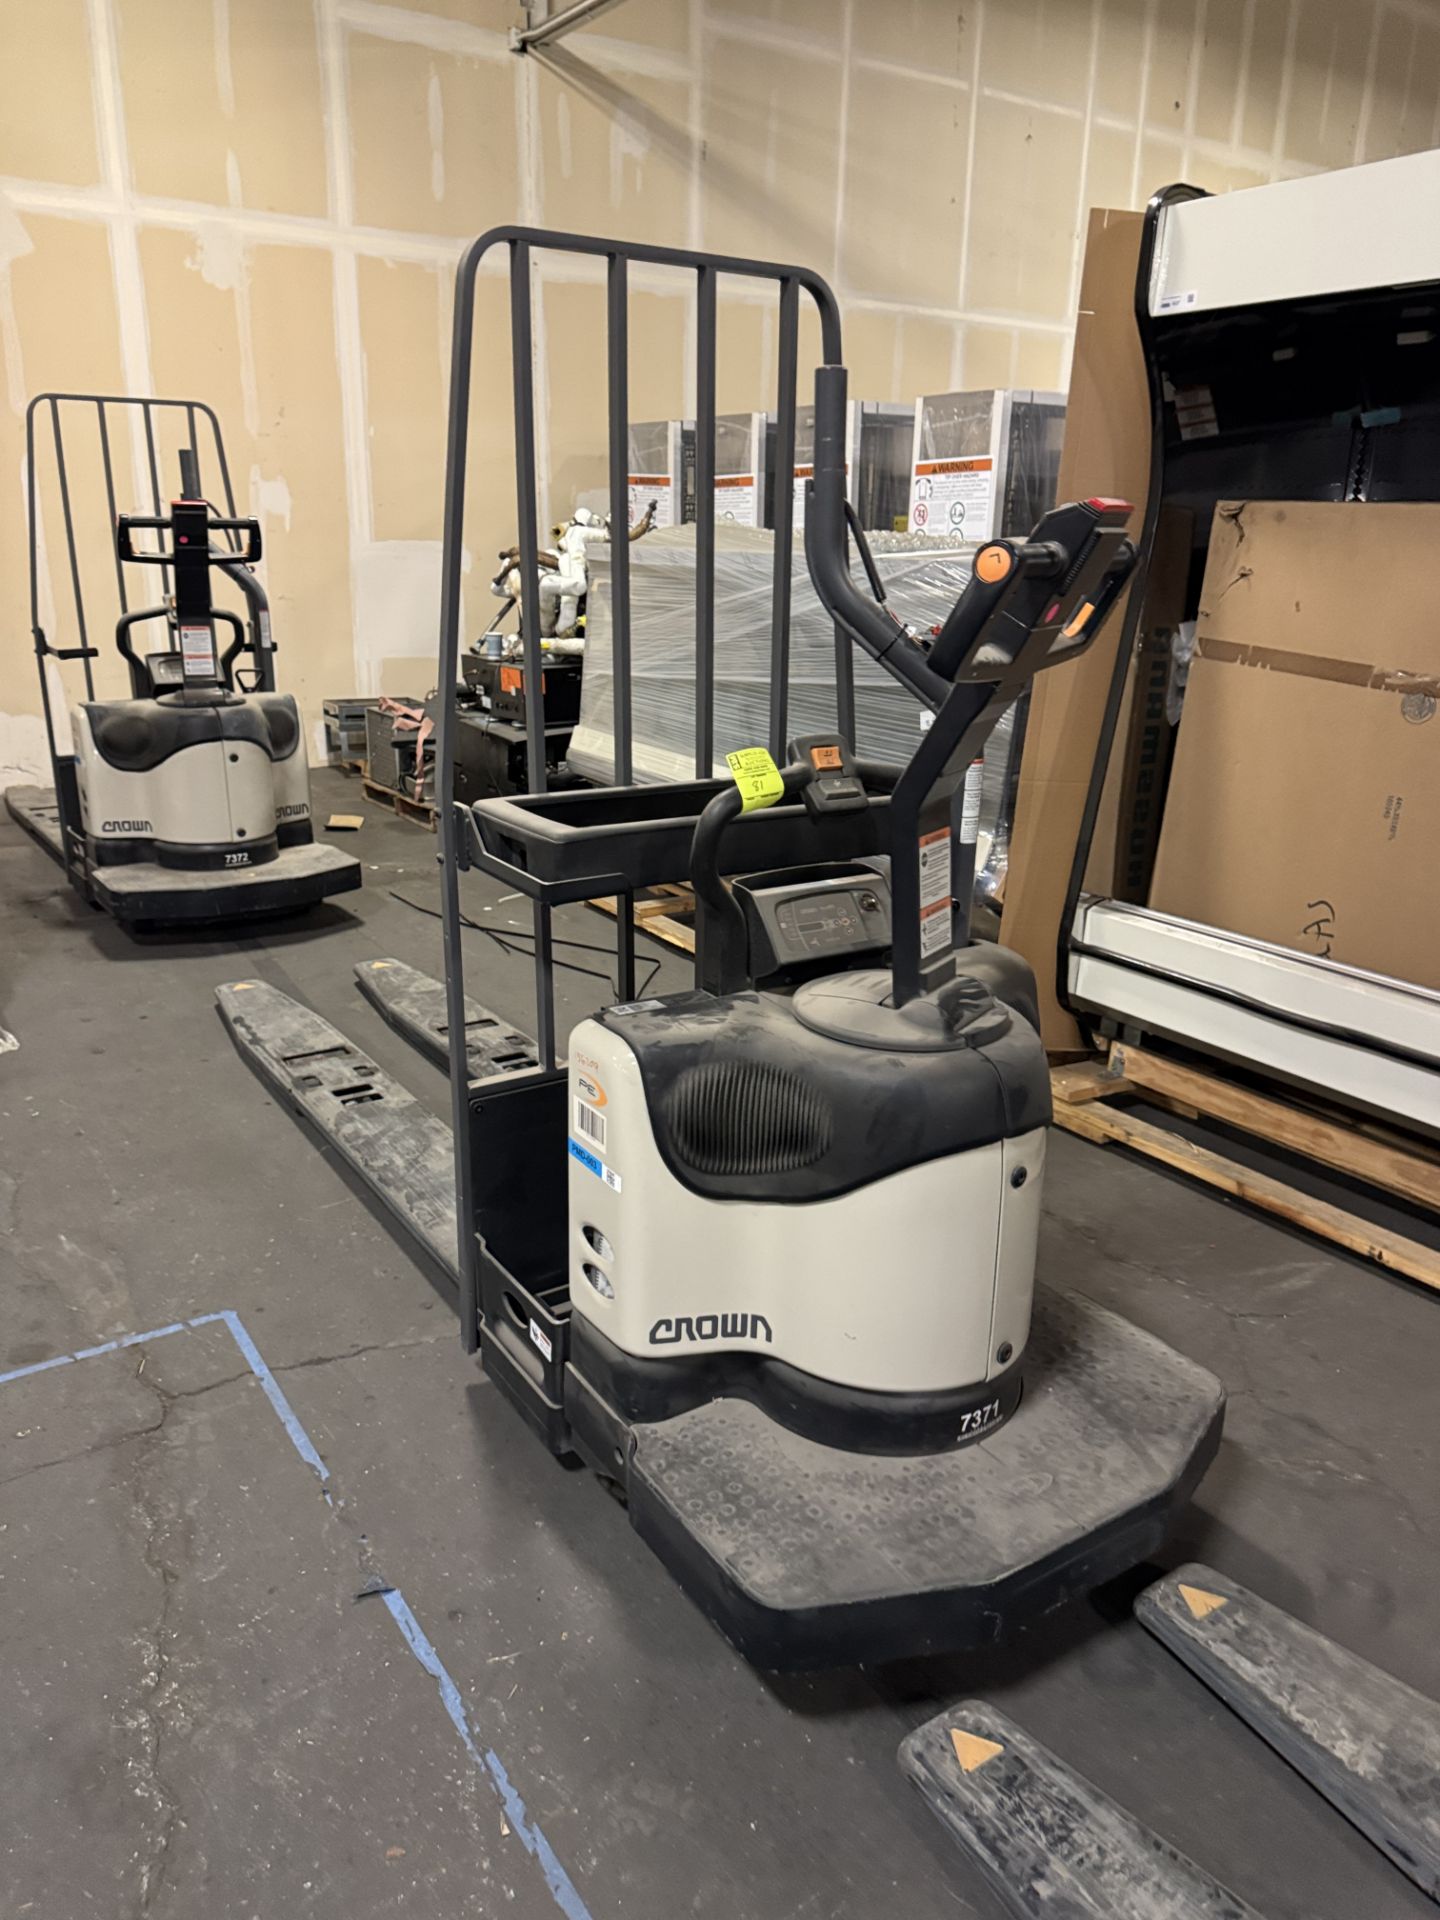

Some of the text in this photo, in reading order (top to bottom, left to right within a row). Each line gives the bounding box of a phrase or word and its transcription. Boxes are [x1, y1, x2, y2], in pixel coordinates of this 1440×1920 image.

[938, 461, 974, 474] WARNING
[752, 780, 764, 792] 81
[102, 820, 153, 833] CROWN
[225, 852, 249, 864] 7372
[578, 1078, 597, 1098] PE
[649, 1311, 773, 1346] CROWN
[960, 1398, 1000, 1433] 7371
